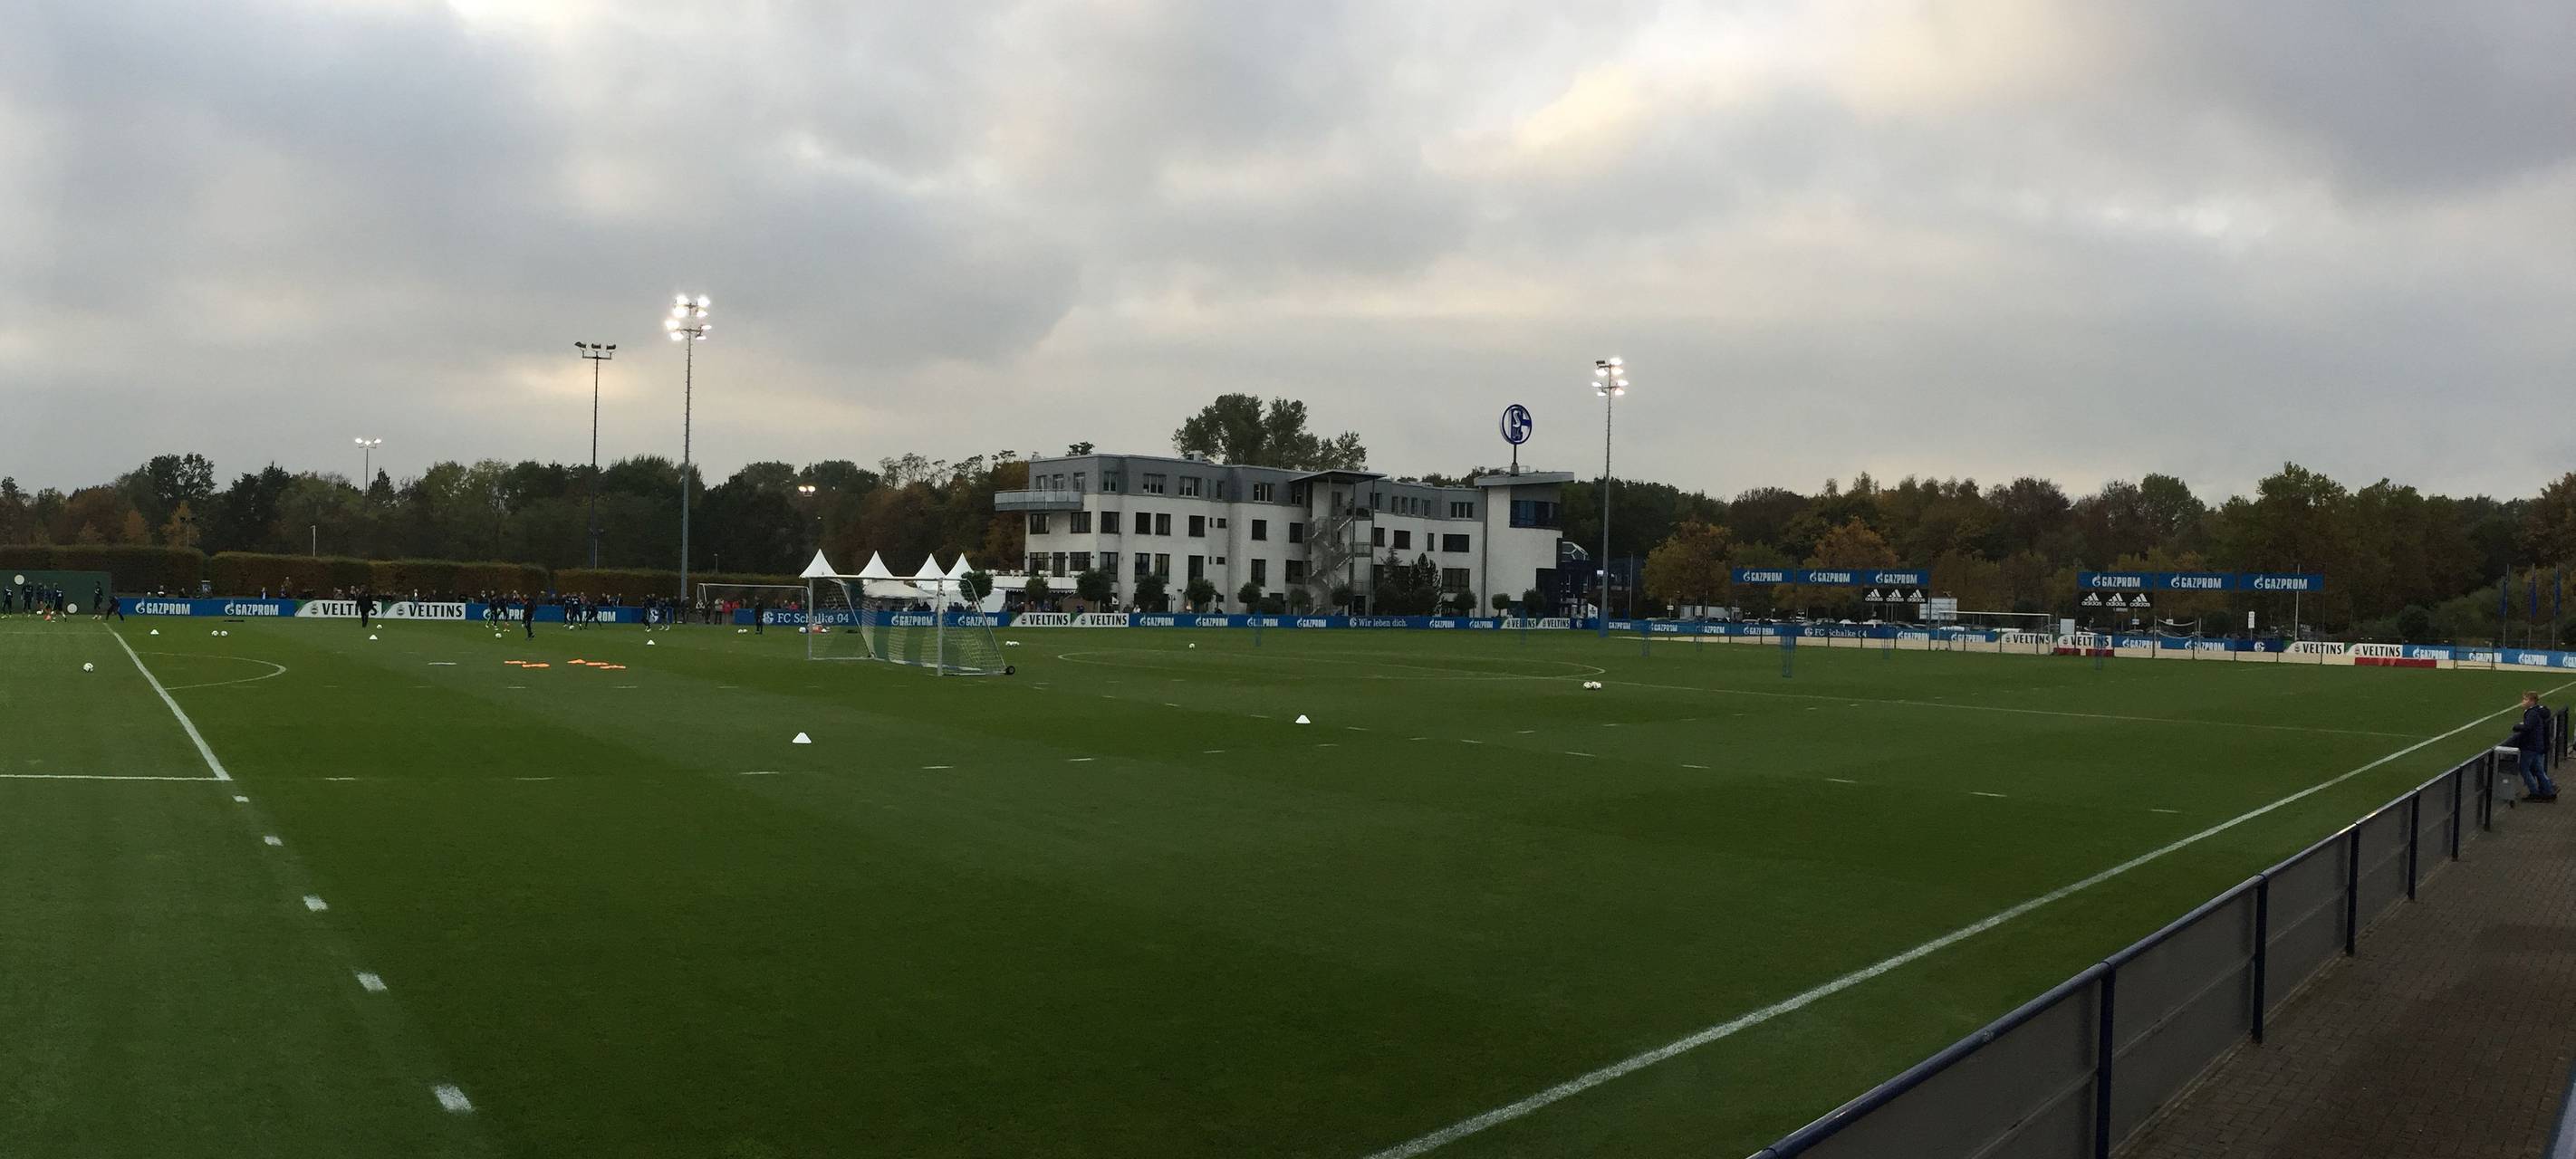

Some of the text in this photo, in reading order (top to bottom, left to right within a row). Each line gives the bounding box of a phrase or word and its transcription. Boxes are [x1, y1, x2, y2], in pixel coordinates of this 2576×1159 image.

[1751, 572, 1783, 582] GAZPROM
[1817, 572, 1850, 583] GAZPROM
[1884, 573, 1918, 584] GAZPROM
[2101, 577, 2140, 588] GAZPROM
[2181, 577, 2222, 589] GAZPROM
[2264, 579, 2308, 589] GAZPROM
[147, 604, 190, 615] GAZPROM
[235, 604, 279, 616] GAZPROM
[322, 602, 378, 617] VELTIS
[409, 605, 463, 618] VELTINS
[777, 613, 790, 623] FC
[837, 613, 850, 623] 04
[899, 617, 934, 626] GAZPROM
[1029, 615, 1069, 626] VELTINS
[1091, 615, 1128, 626] VELTINS
[1147, 617, 1175, 626] GAZPROM
[1202, 618, 1228, 627] GAZPROM
[1302, 618, 1327, 627] GAZPROM
[1359, 618, 1408, 627] Wir leben dich.
[1547, 618, 1571, 628] VELTINS
[1434, 620, 1455, 628] GAZPROM
[1474, 620, 1494, 628] GAZPROM
[1608, 622, 1631, 630] GAZPROM
[2302, 643, 2342, 654] VELTINS
[2362, 646, 2401, 656] VELTINS
[2420, 649, 2450, 659] GAZPROM
[2524, 654, 2548, 665] GAZPROM
